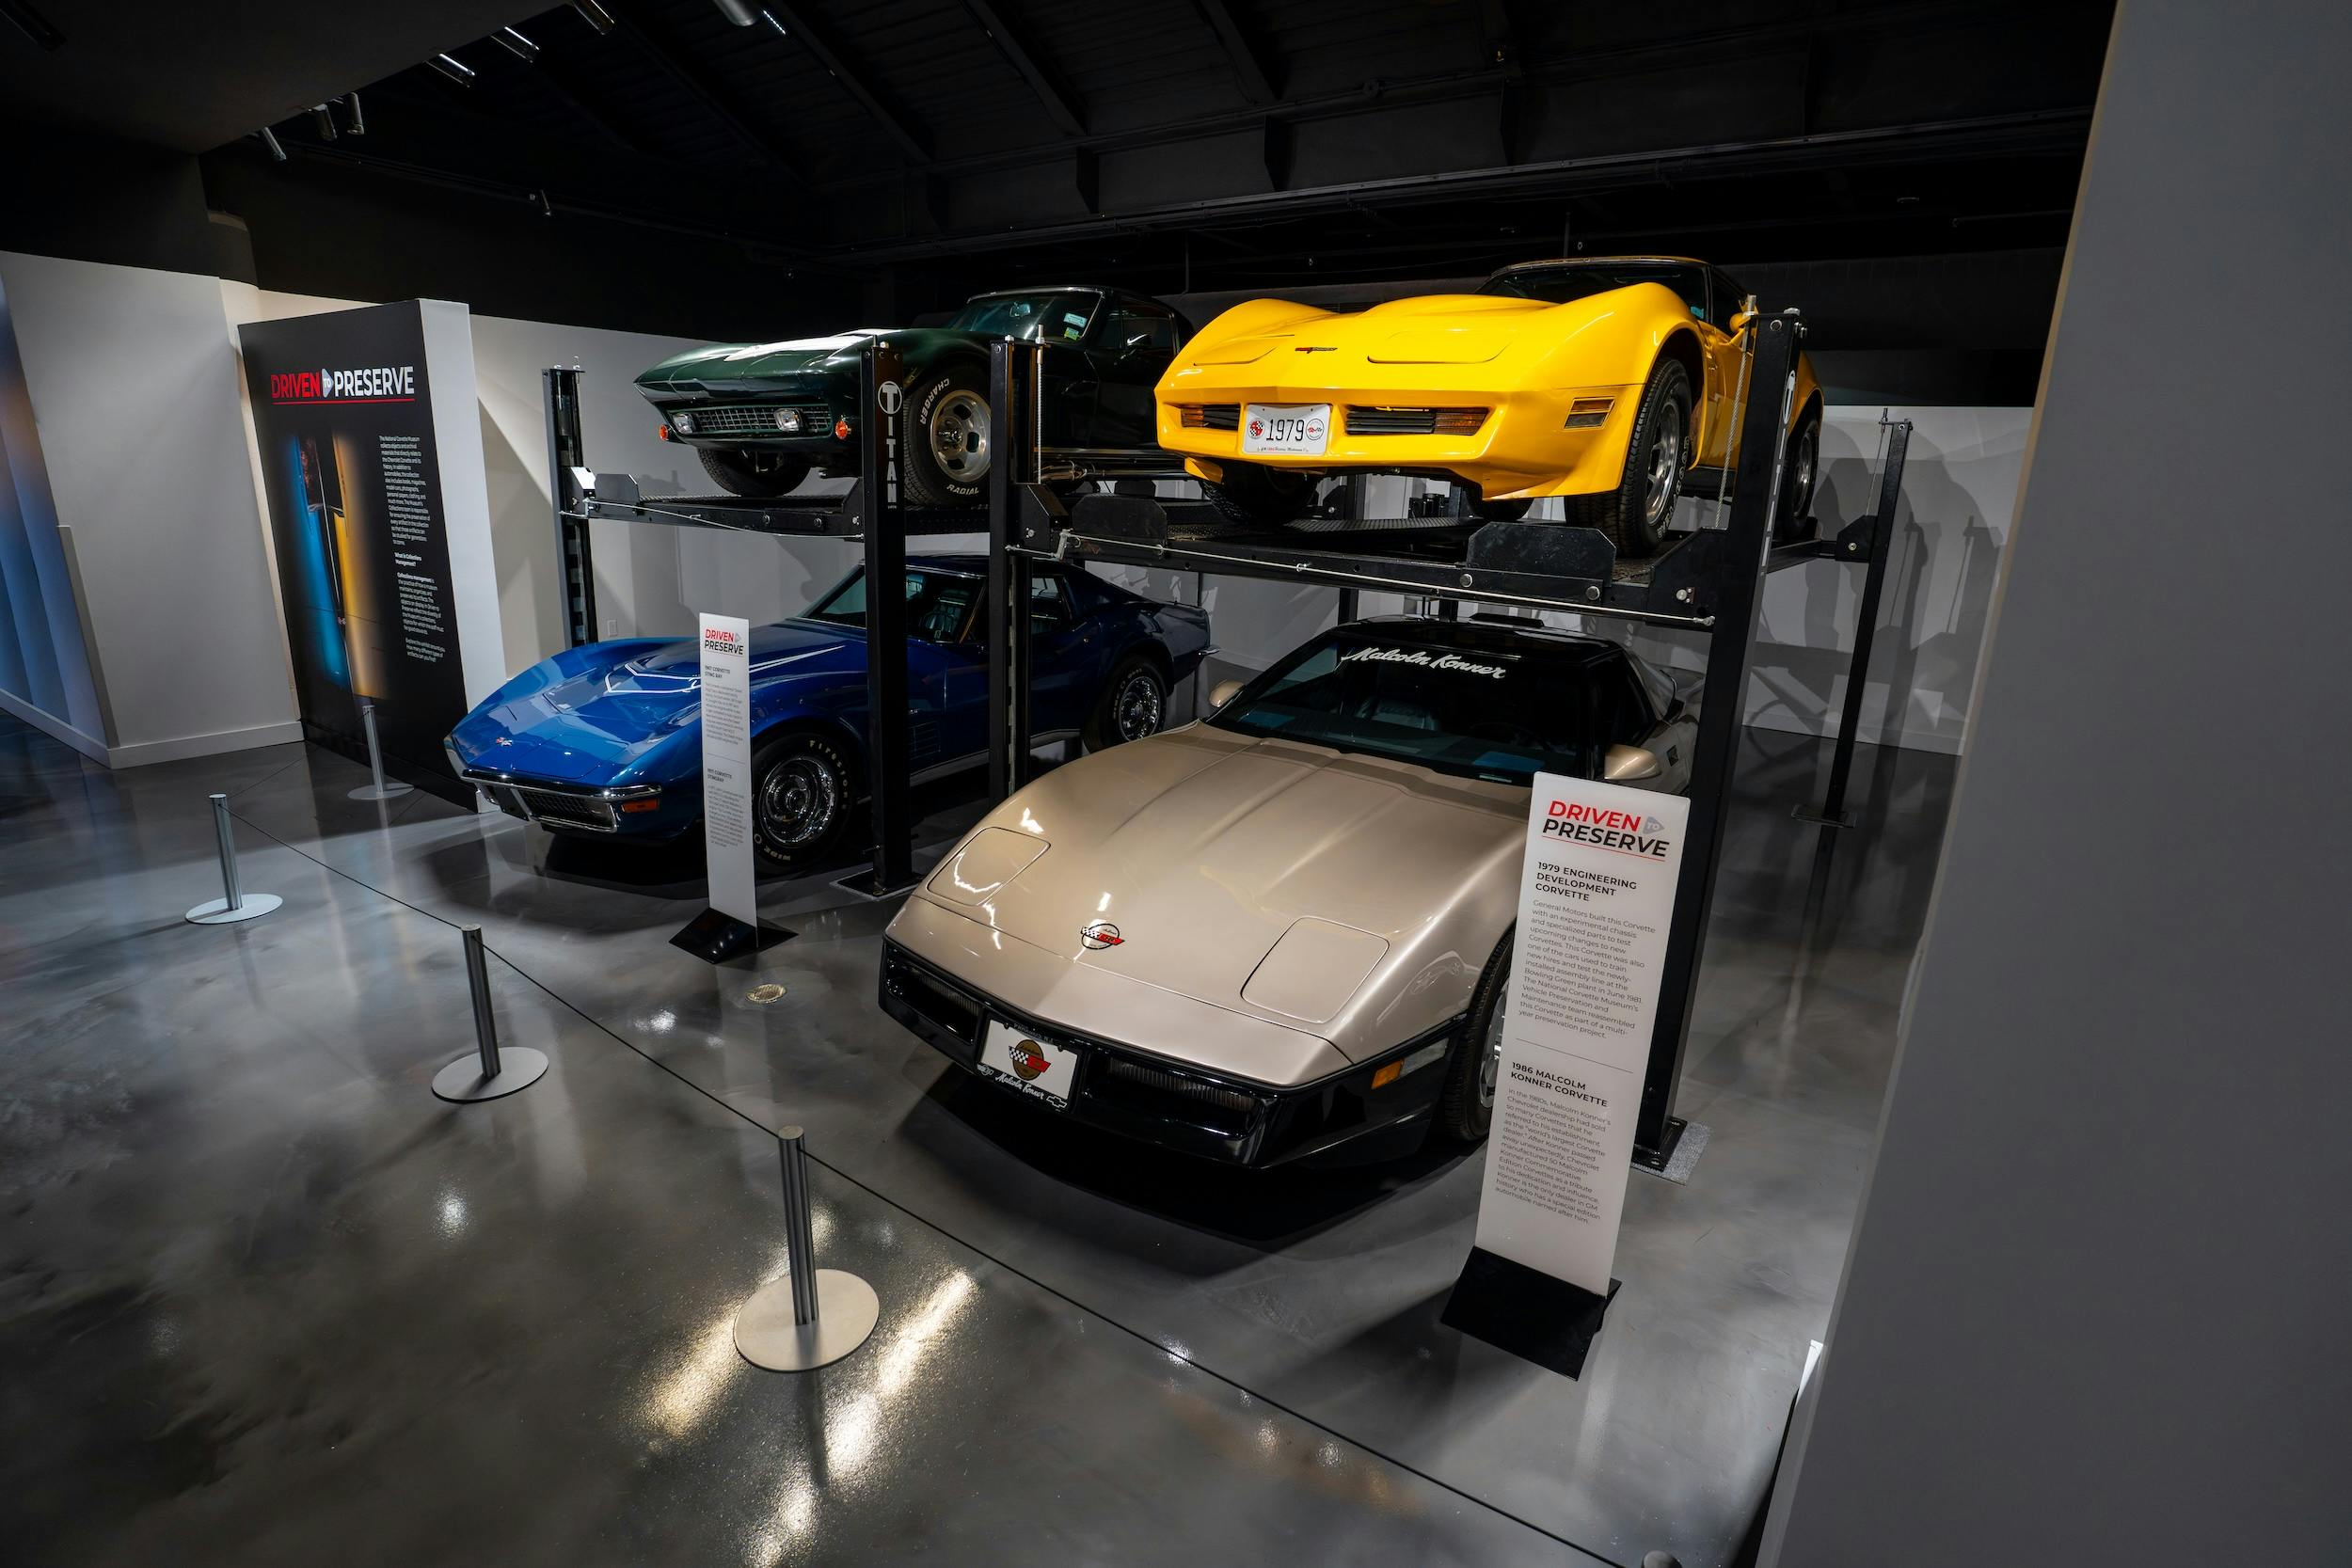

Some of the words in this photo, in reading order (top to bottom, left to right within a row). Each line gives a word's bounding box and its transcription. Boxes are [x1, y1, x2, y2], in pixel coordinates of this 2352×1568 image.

[271, 372, 320, 399] DRIVEN
[334, 367, 414, 397] PRESERVE
[920, 378, 950, 425] CHARGER
[882, 383, 899, 503] TITAN
[1266, 419, 1305, 441] 1979
[946, 483, 979, 495] RADIAL
[705, 640, 743, 655] PRESERVE
[706, 628, 734, 641] DRIVEN
[1341, 647, 1432, 666] Malcolm
[1430, 654, 1507, 679] Konner
[1548, 800, 1642, 832] DRIVEN
[1645, 821, 1660, 831] TO
[1543, 818, 1670, 858] PRESERVE
[1536, 872, 1616, 896] DEVELOPMENT
[1537, 862, 1560, 873] 1979
[1563, 867, 1637, 890] ENGINEERING
[1535, 882, 1590, 902] CORVETTE
[1532, 908, 1547, 917] with
[1560, 914, 1608, 933] experimental
[1609, 926, 1637, 939] chassis
[1533, 899, 1561, 911] General
[1563, 906, 1588, 918] Motors
[1589, 912, 1606, 922] built
[1607, 916, 1621, 926] this
[1623, 920, 1655, 933] Corvette
[1530, 926, 1566, 942] upcoming
[1567, 934, 1598, 949] changes
[1610, 946, 1626, 955] new
[1531, 916, 1544, 926] and
[1546, 920, 1585, 937] specialized
[1586, 929, 1606, 942] parts
[1616, 937, 1630, 946] test
[1543, 955, 1560, 964] hires
[1562, 959, 1575, 969] and
[1577, 963, 1591, 973] test
[1592, 967, 1605, 976] the
[1550, 948, 1563, 957] the
[1581, 956, 1598, 965] used
[1609, 962, 1627, 973] train
[1565, 942, 1580, 952] This
[1581, 946, 1612, 959] Corvette
[1613, 956, 1628, 964] was
[1629, 958, 1645, 968] also
[1523, 975, 1535, 984] The
[1537, 979, 1566, 992] National
[1568, 988, 1598, 1001] Corvette
[1524, 967, 1552, 982] Bowling
[1554, 975, 1576, 987] Green
[1577, 981, 1596, 993] plant
[1606, 989, 1625, 999] June
[1525, 958, 1554, 972] installed
[1556, 967, 1589, 982] assembly
[1591, 975, 1604, 985] line
[1615, 982, 1628, 990] the
[1521, 992, 1565, 1010] Maintenance
[1567, 1005, 1586, 1016] team
[1588, 1010, 1634, 1029] reassembled
[1522, 984, 1547, 996] Vehicle
[1549, 991, 1592, 1008] Preservation
[1594, 1004, 1608, 1013] and
[1518, 1009, 1533, 1019] year
[1534, 1013, 1578, 1032] preservation
[1519, 1001, 1533, 1009] this
[1534, 1005, 1563, 1018] Corvette
[1574, 1016, 1589, 1026] part
[994, 1072, 1023, 1090] Malcolm
[1022, 1085, 1045, 1101] Konner
[1511, 1071, 1552, 1090] KONNER
[1554, 1085, 1609, 1108] CORVETTE
[1512, 1061, 1534, 1074] 1986
[1535, 1069, 1586, 1091] MALCOLM
